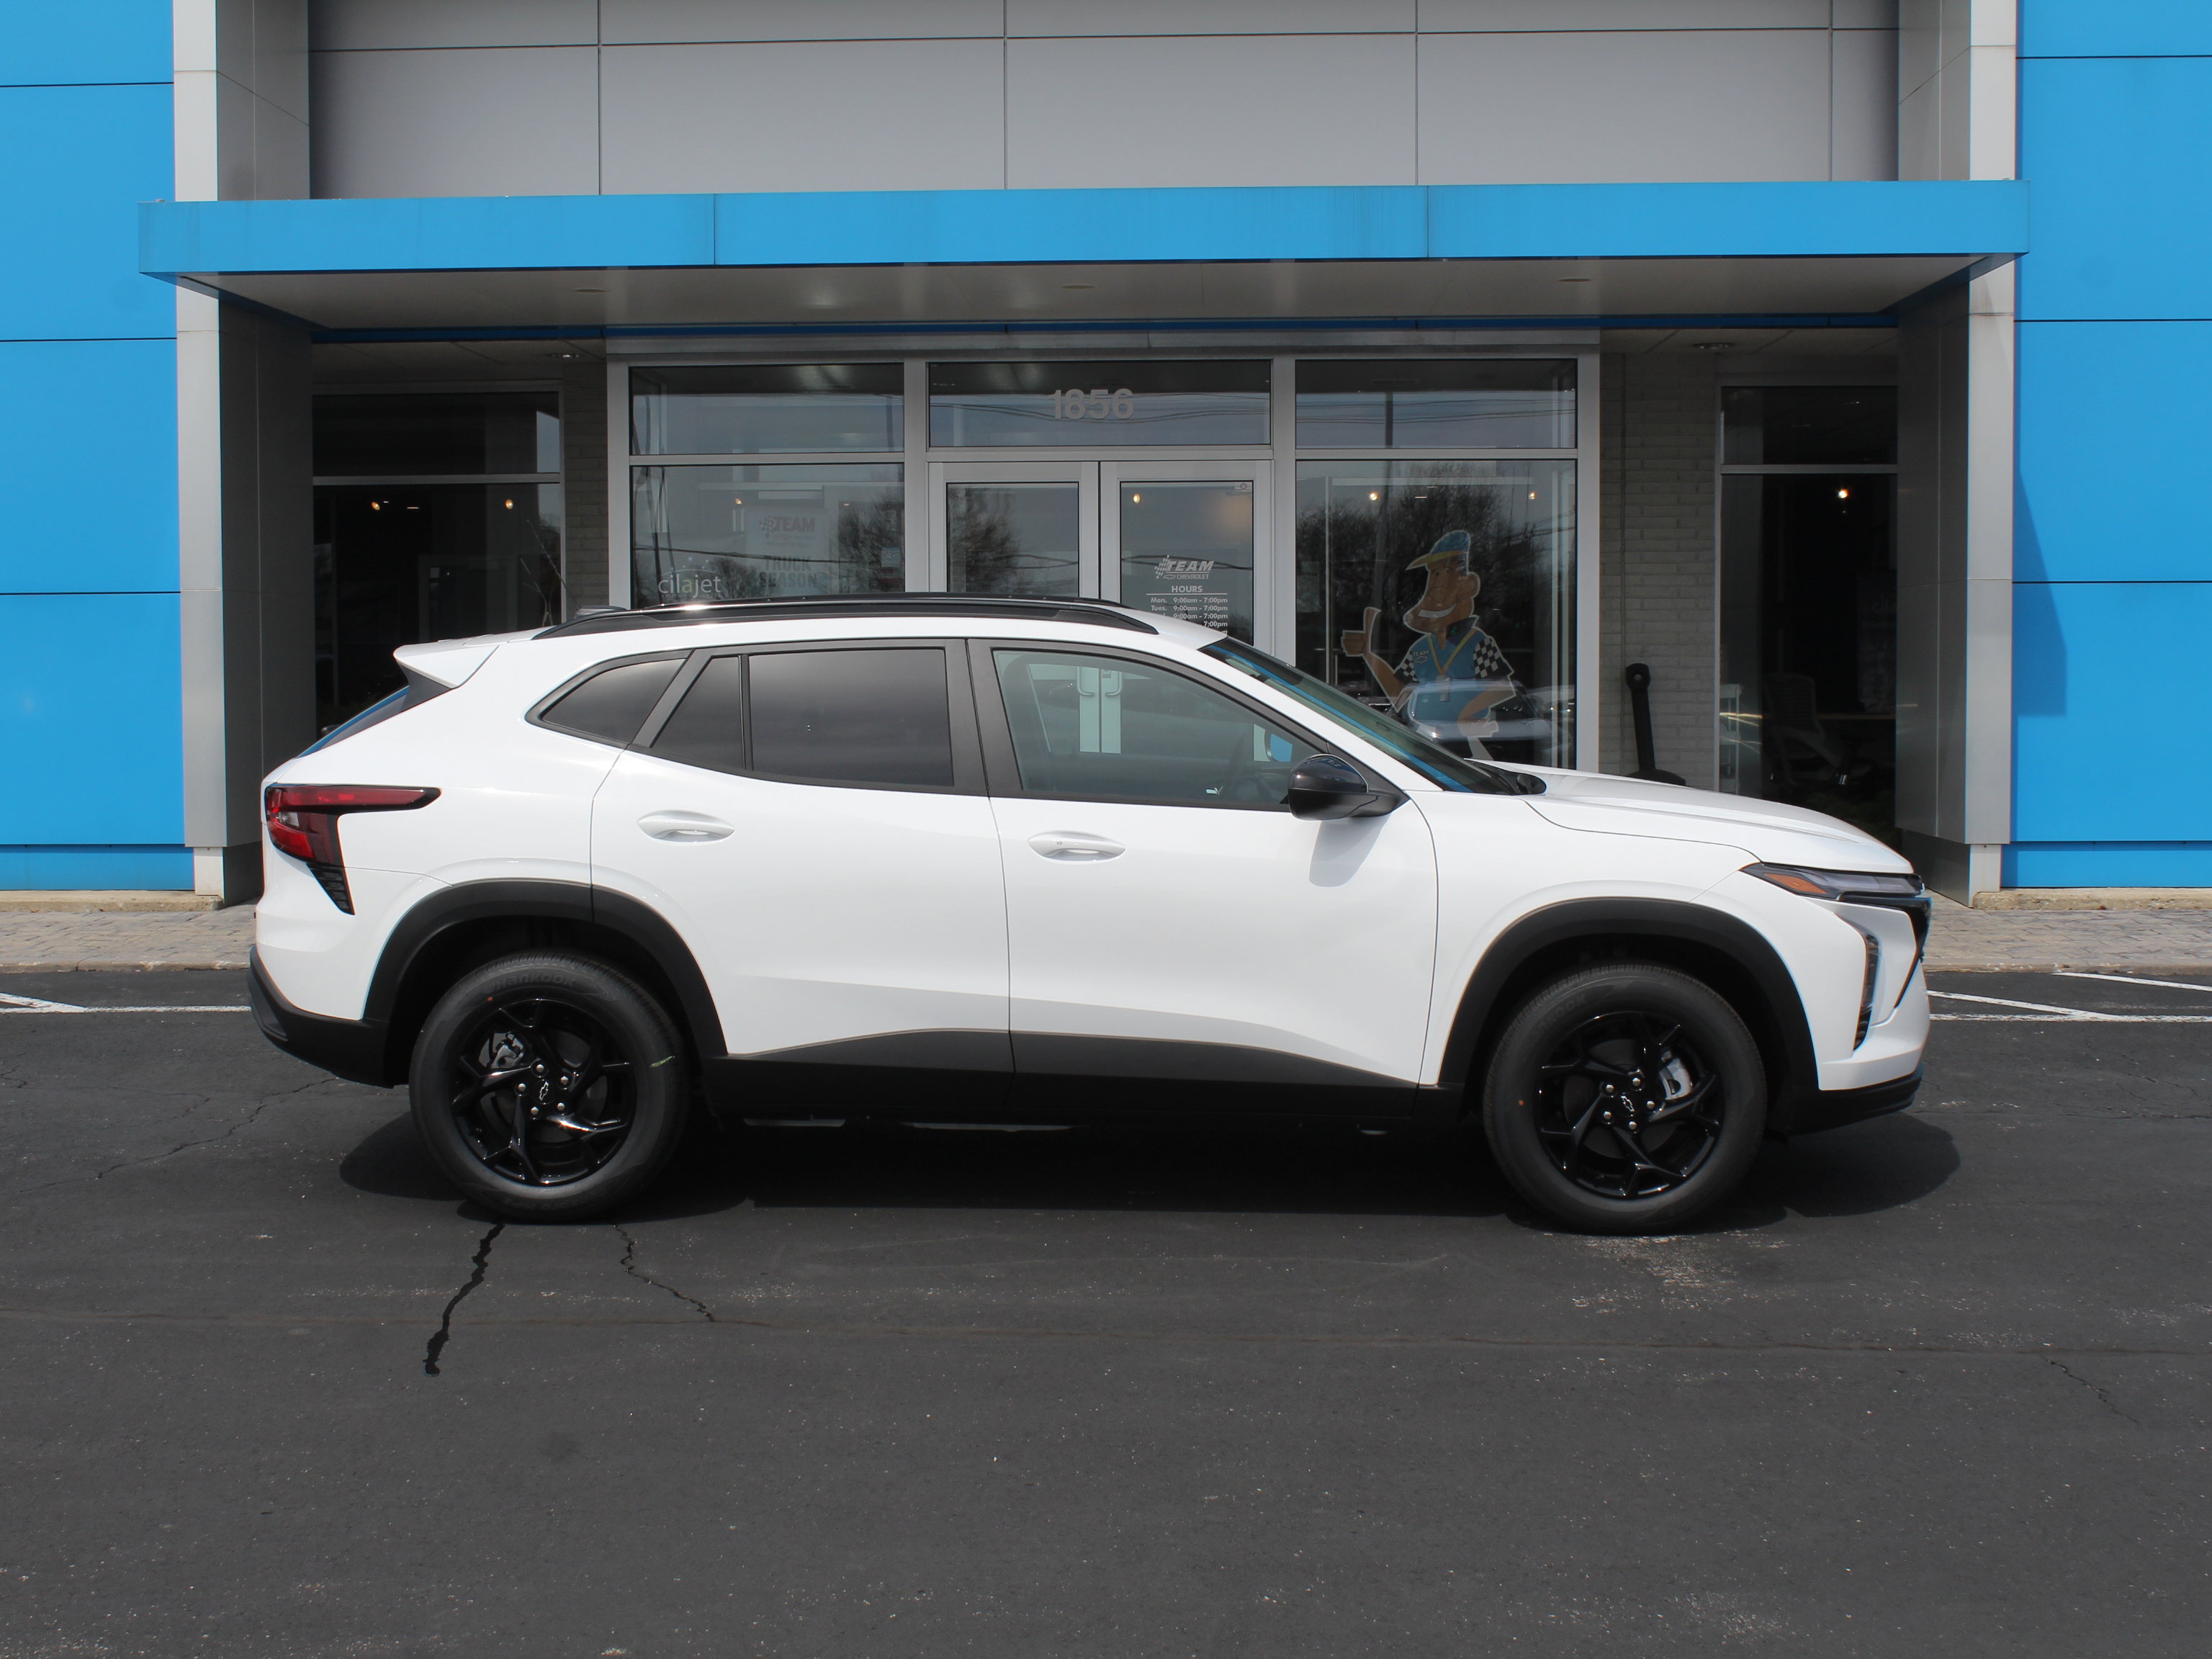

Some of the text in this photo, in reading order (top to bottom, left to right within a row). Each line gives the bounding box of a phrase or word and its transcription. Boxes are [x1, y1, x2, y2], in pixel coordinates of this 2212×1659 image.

[1049, 388, 1134, 420] 1856
[773, 516, 816, 533] TEAM
[1166, 560, 1214, 572] TEAM
[658, 573, 721, 598] cilajet
